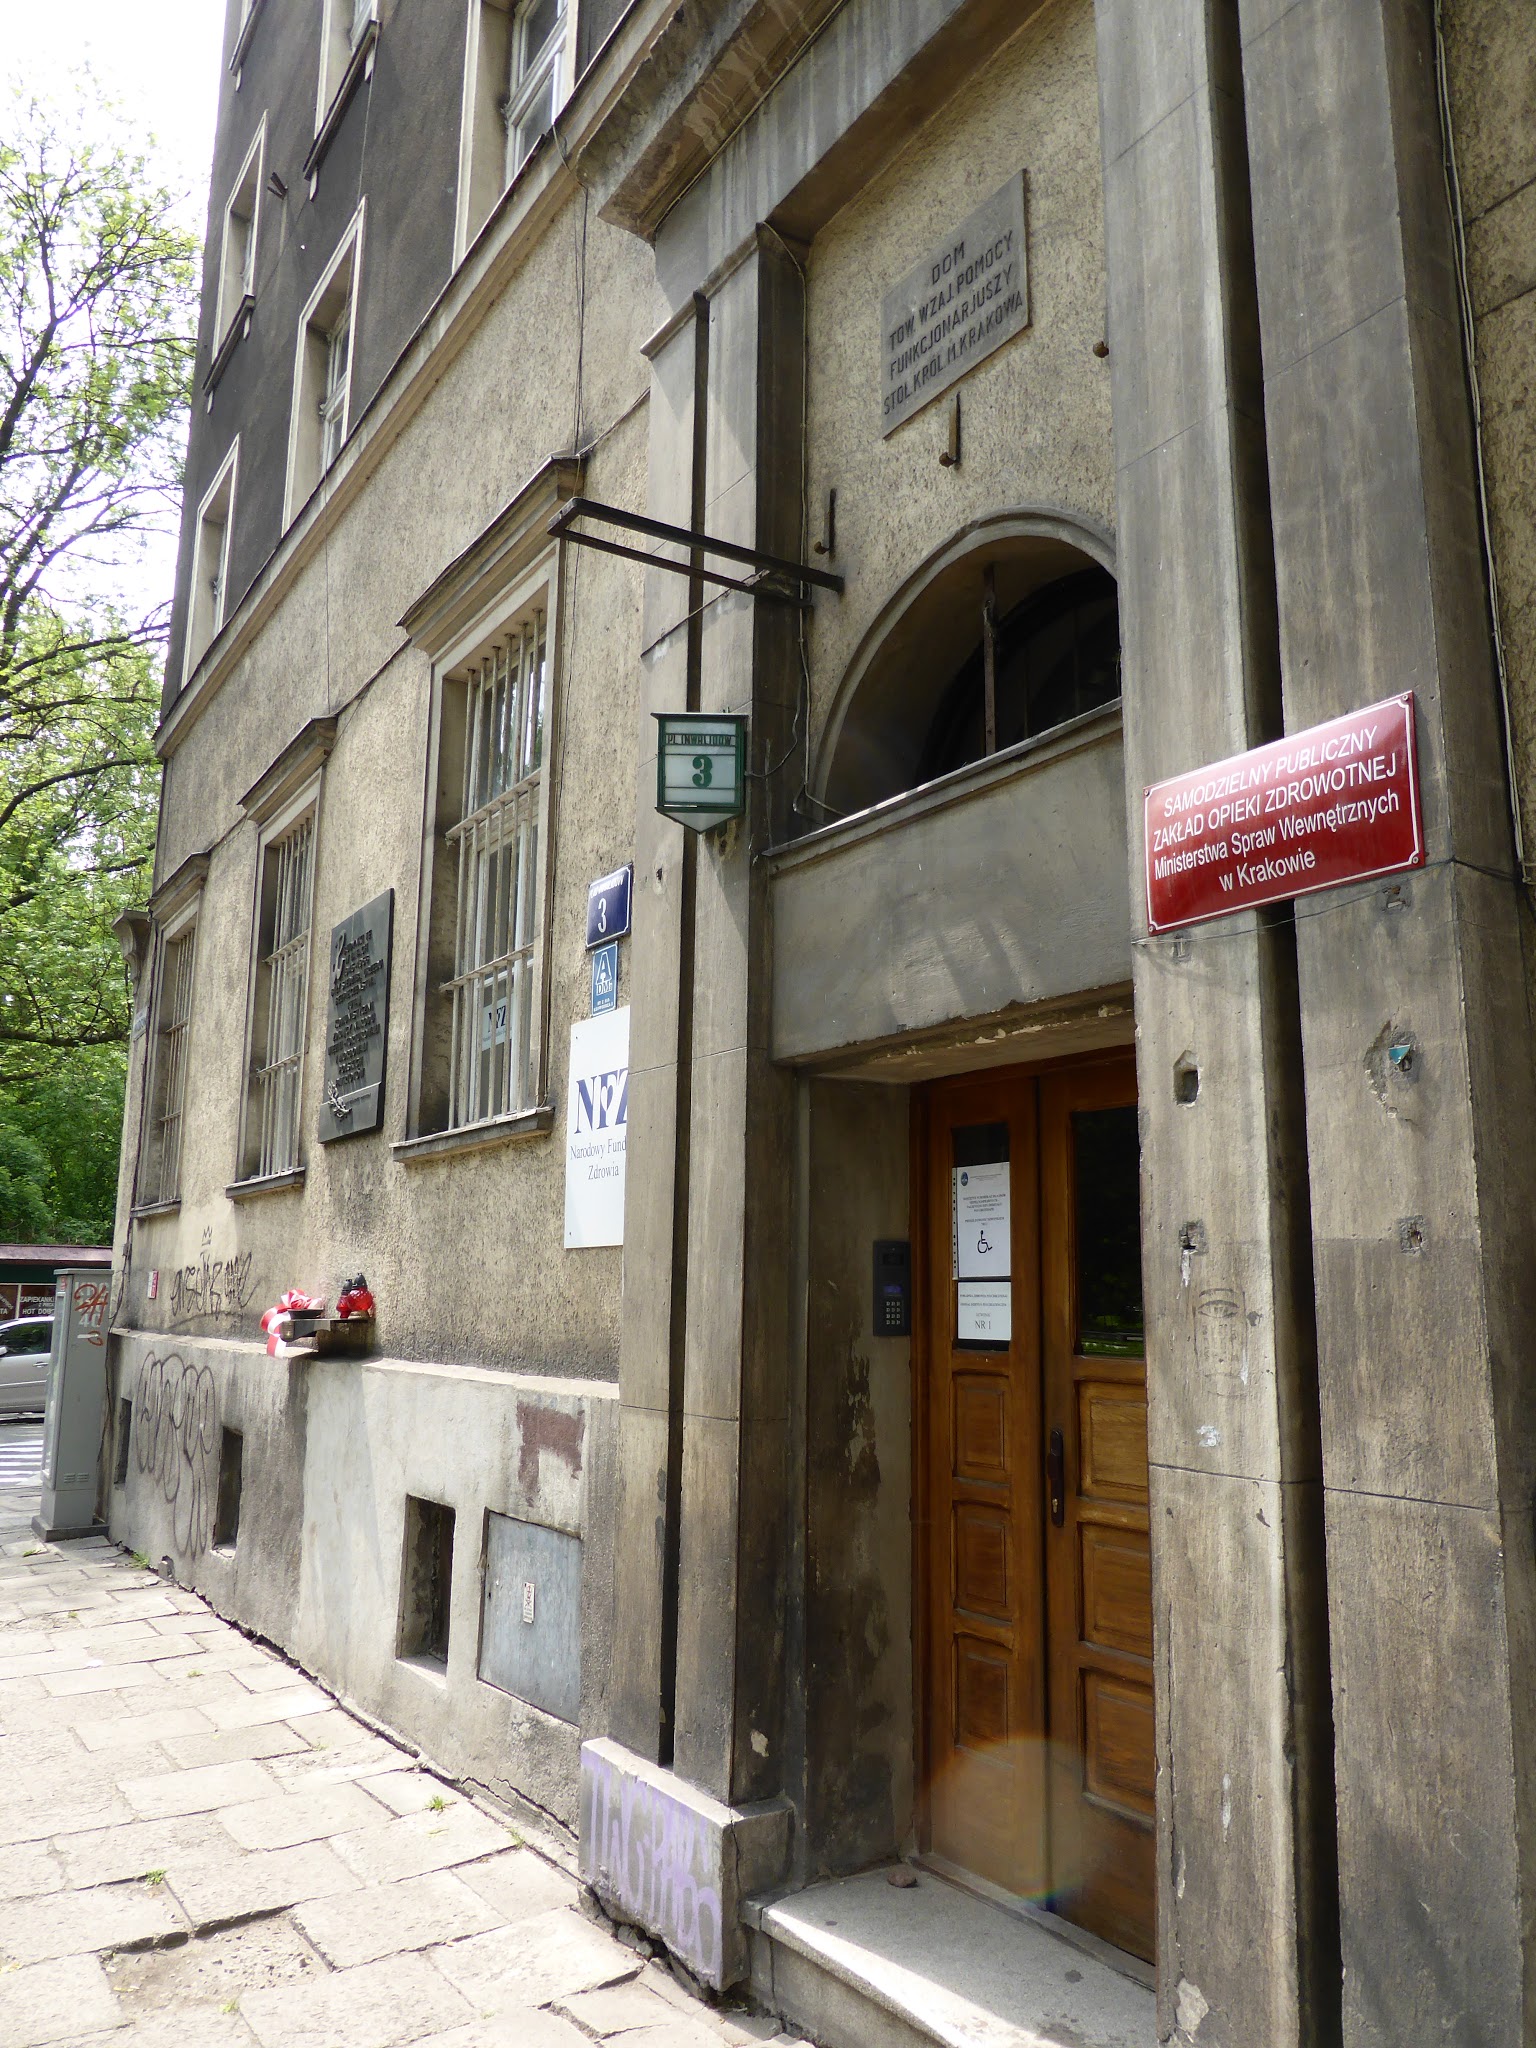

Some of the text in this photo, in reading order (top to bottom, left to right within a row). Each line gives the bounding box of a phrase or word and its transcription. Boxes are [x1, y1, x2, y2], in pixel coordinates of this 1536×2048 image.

[932, 241, 965, 285] DOM
[889, 316, 916, 352] TOW.
[957, 230, 1013, 296] POMOCY
[890, 263, 1013, 381] FUNKCJONARJUSZY
[959, 290, 1023, 357] KRAKOWA
[692, 755, 712, 788] 3
[1164, 725, 1378, 818] SAMODZIELNY PUBLICZNY
[1153, 753, 1397, 852] ZAKŁAD OPIEKI ZDROWOTNEJ
[1155, 788, 1400, 880] Ministerstwa Spraw Wewnętrznych
[1219, 848, 1316, 892] w Krakowie
[598, 898, 607, 933] 3
[574, 1067, 628, 1135] NFZ
[570, 1142, 605, 1161] Narodowy
[588, 1161, 620, 1181] Zdrowia
[975, 1320, 986, 1330] NR
